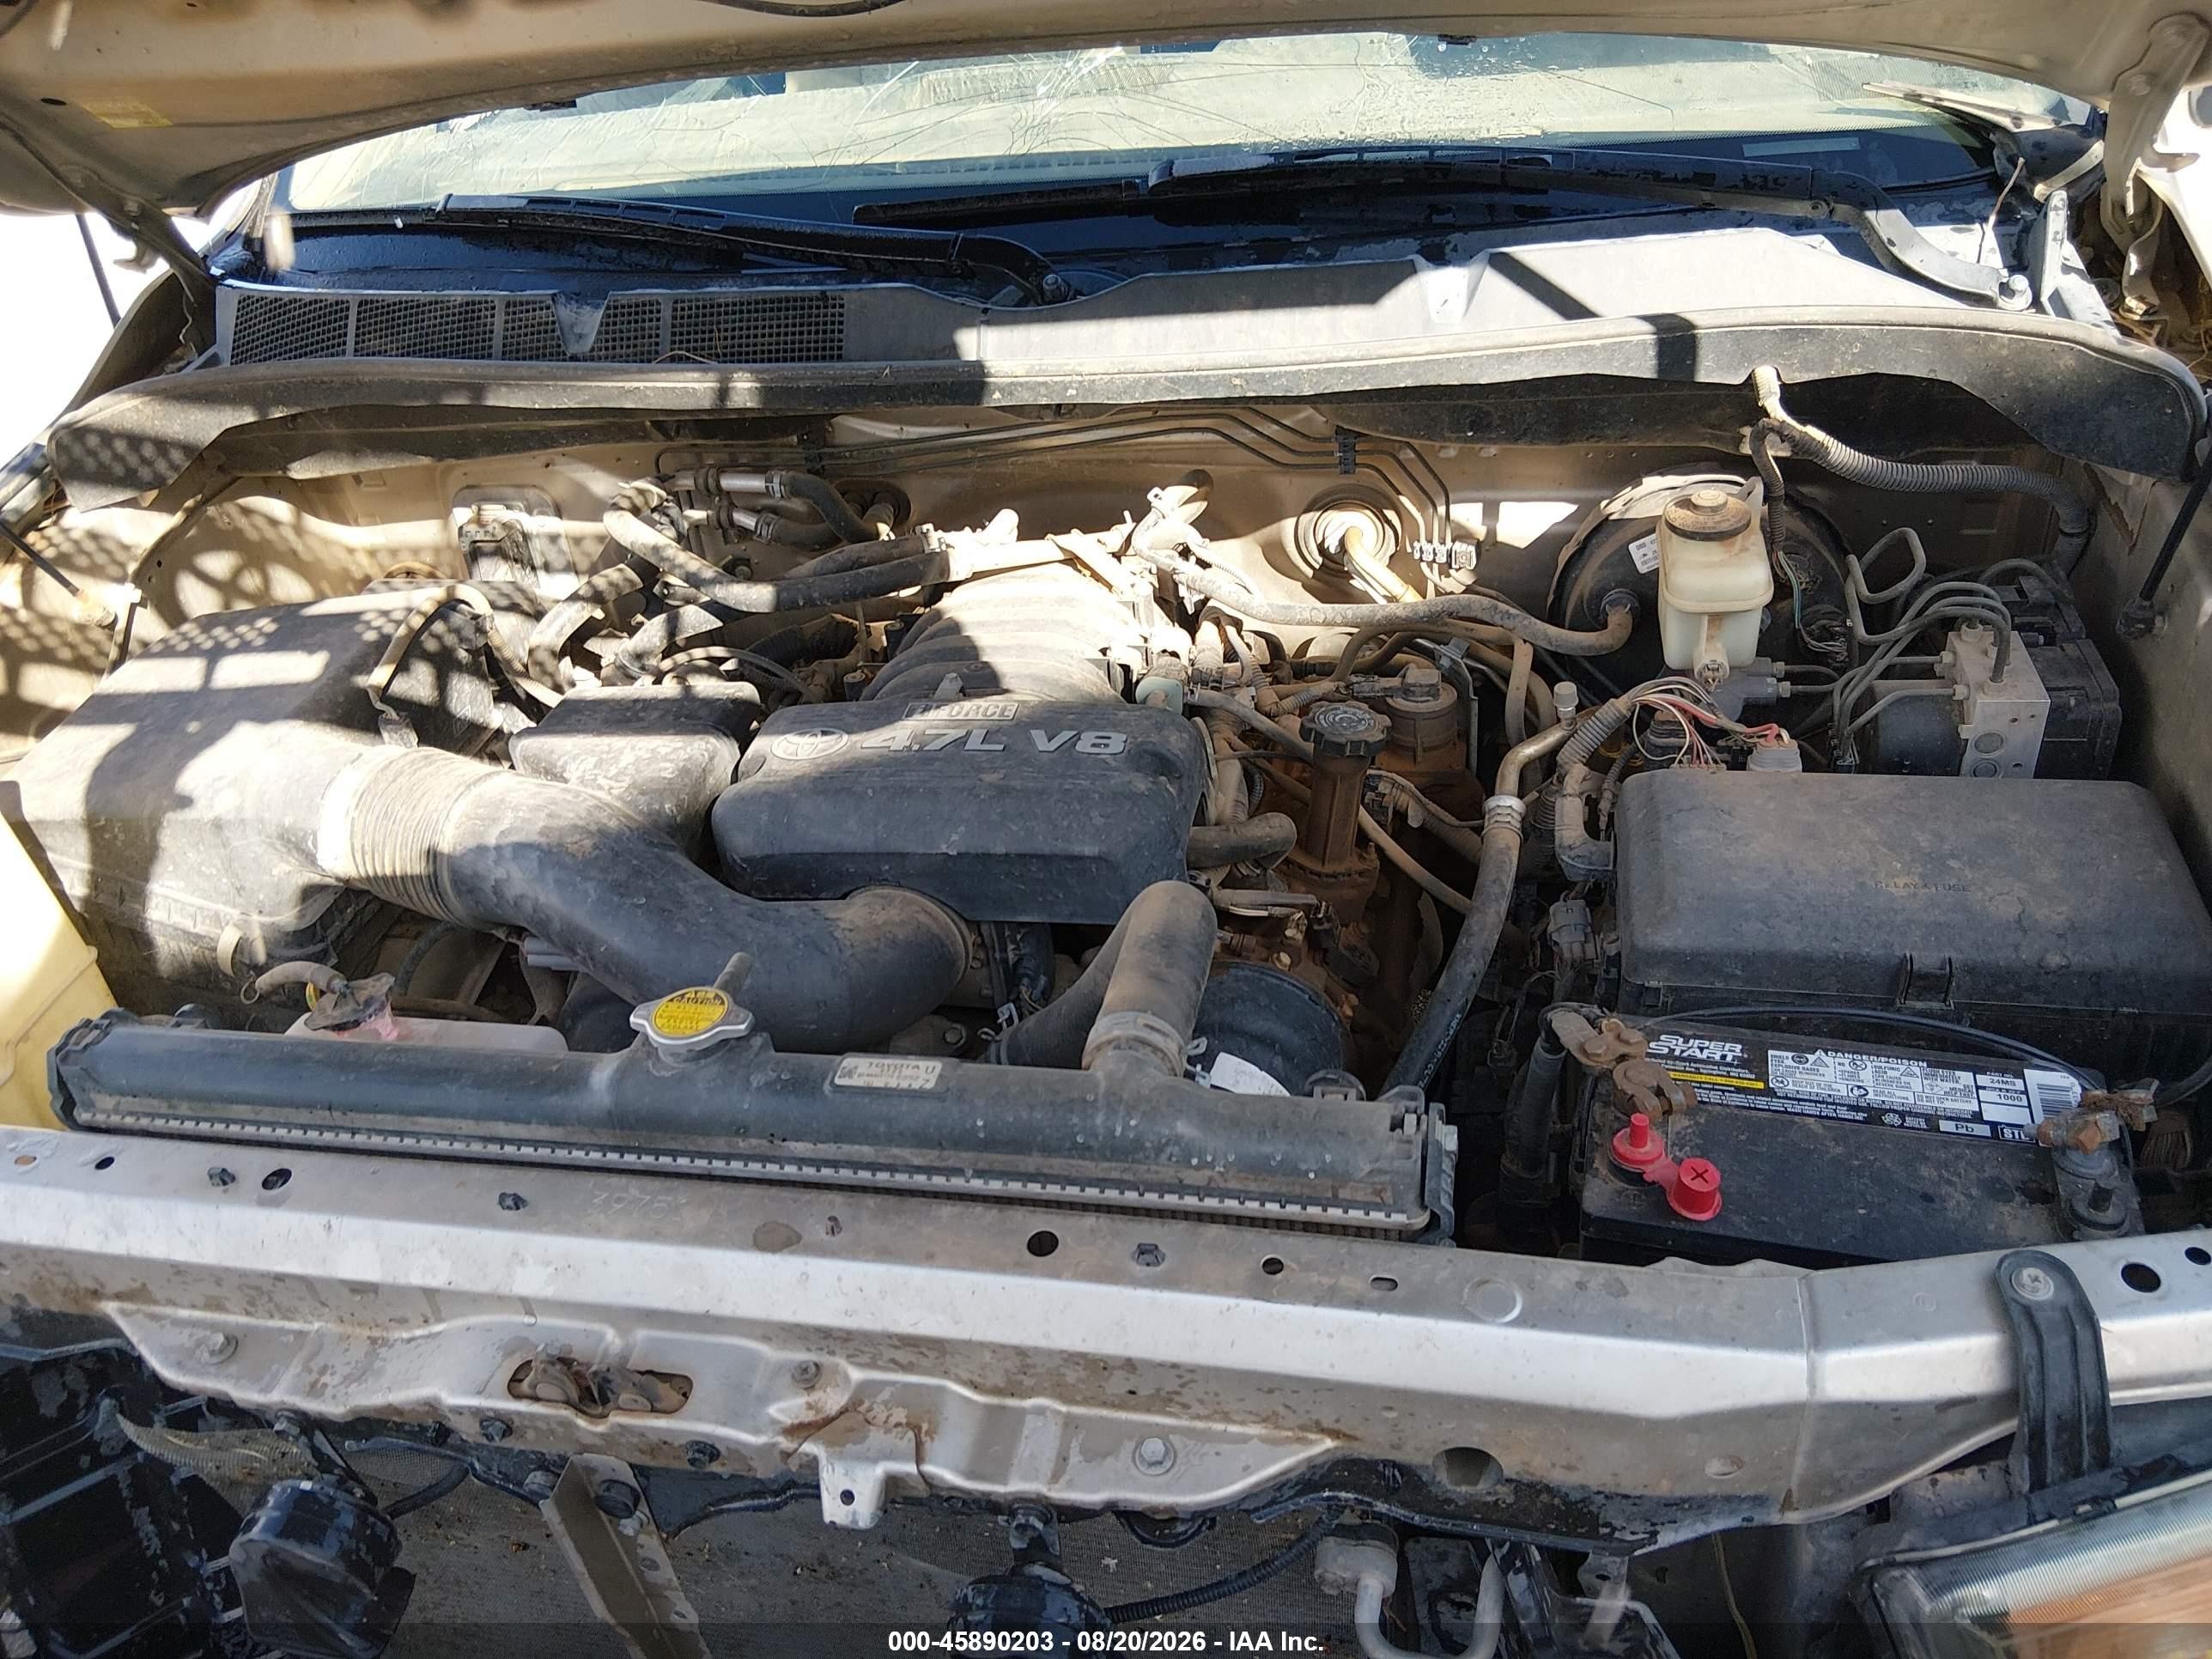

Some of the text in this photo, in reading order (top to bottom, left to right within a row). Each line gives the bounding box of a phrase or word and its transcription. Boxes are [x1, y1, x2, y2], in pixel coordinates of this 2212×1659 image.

[860, 728, 1127, 754] 4.7L V8
[673, 996, 724, 1006] CAUTION
[1659, 1035, 1742, 1052] SUPER
[1647, 1042, 1741, 1061] START
[1827, 1051, 1927, 1067] DANGER/POISON
[868, 1061, 921, 1071] TOYOTA
[1997, 1094, 2023, 1102] 1000
[1955, 1123, 1974, 1133] Pb
